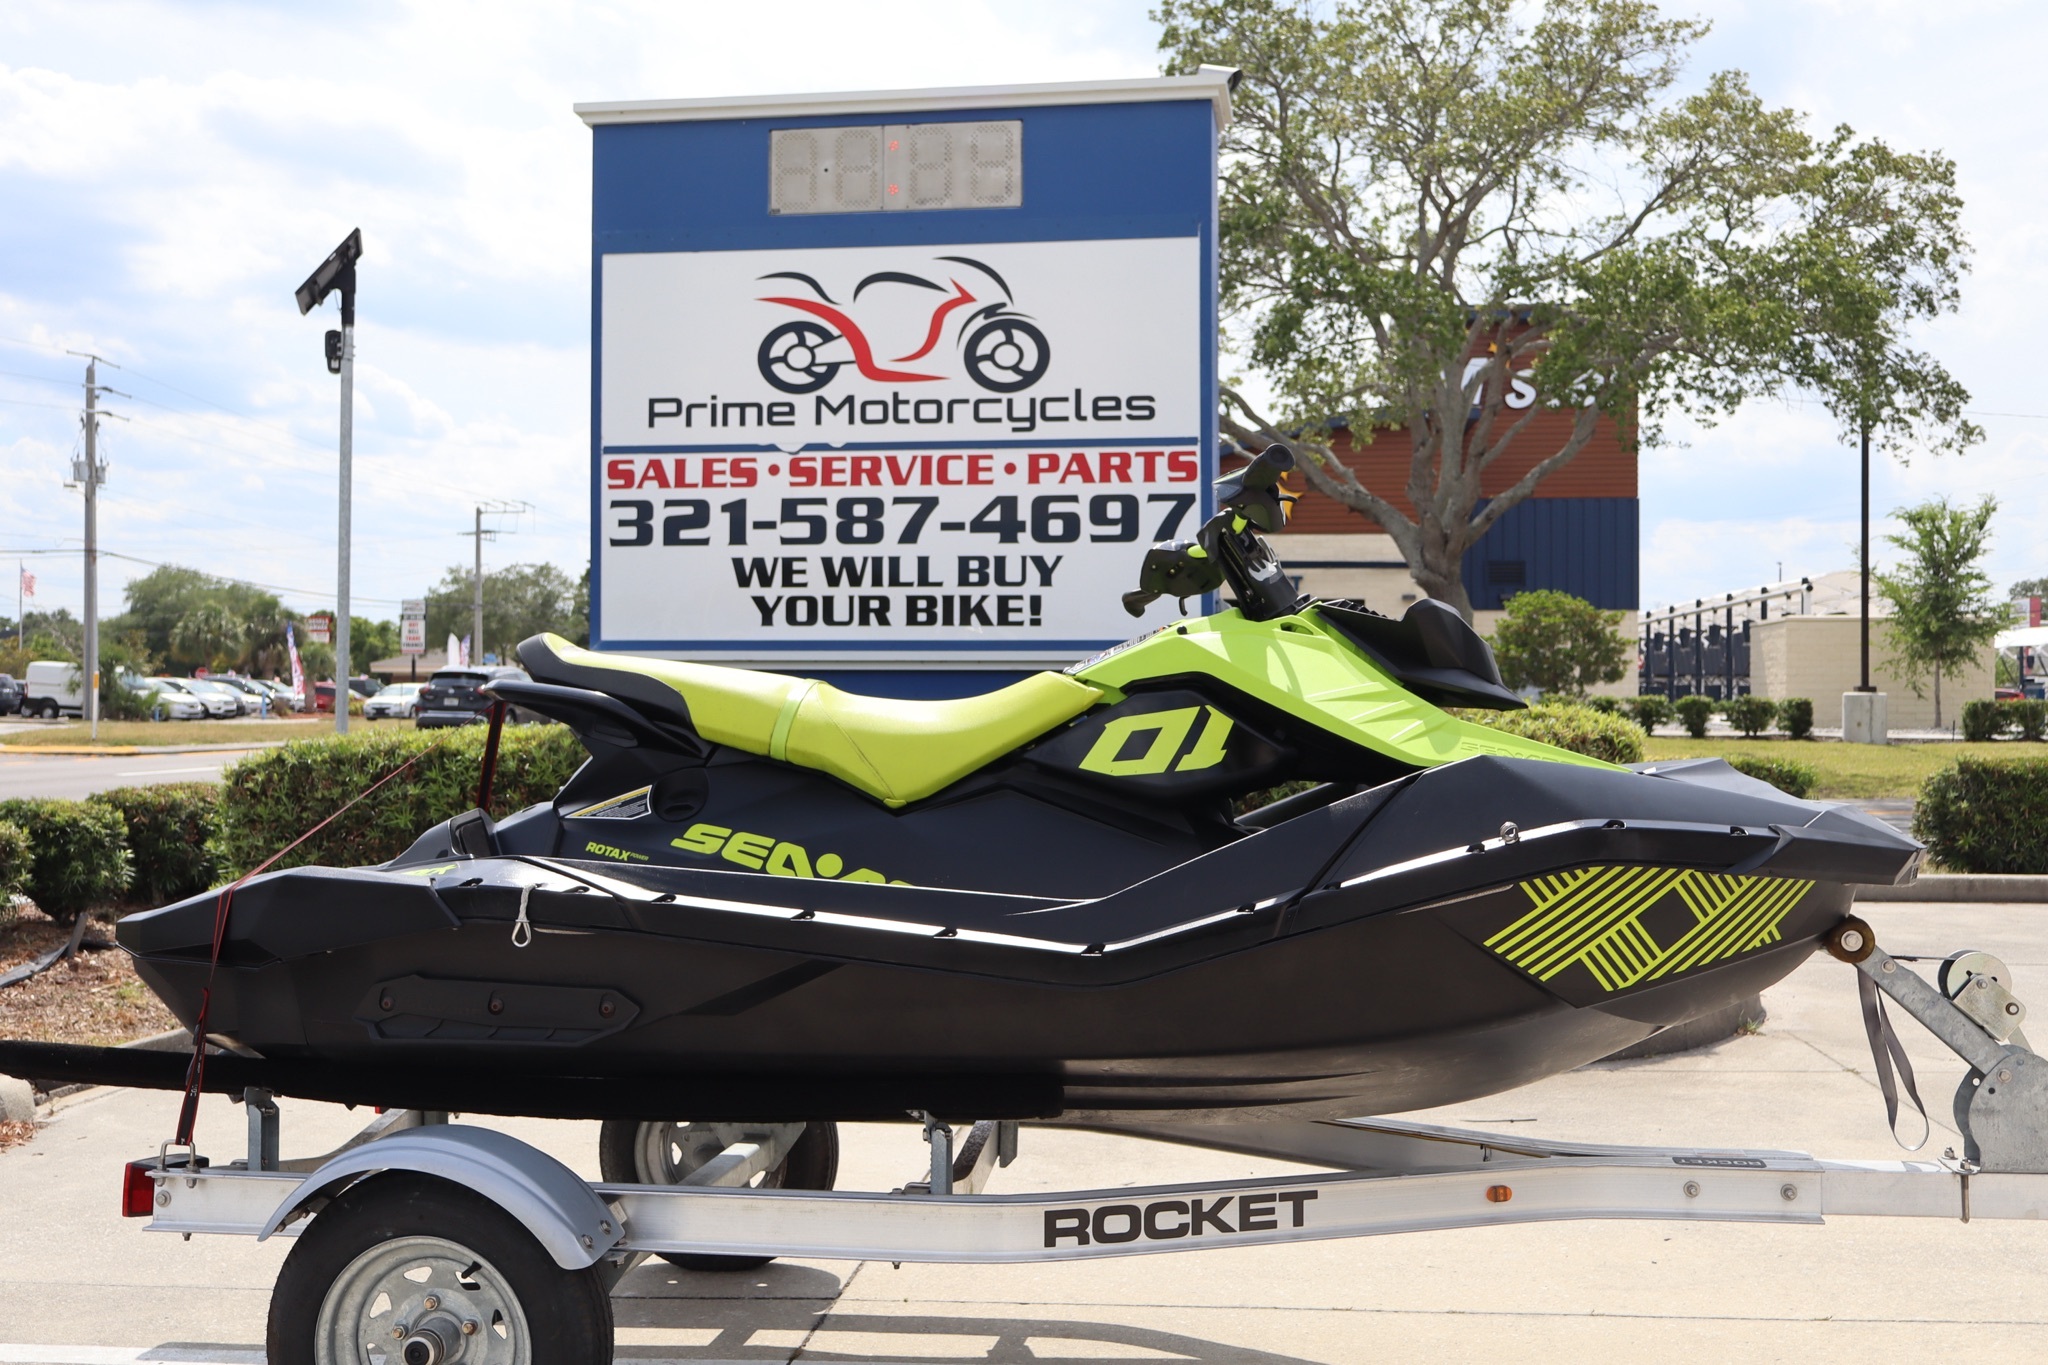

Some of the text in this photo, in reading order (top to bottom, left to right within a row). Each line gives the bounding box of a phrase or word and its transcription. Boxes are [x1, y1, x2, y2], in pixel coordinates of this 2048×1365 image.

[648, 388, 1156, 432] Prime Motorcycles
[607, 450, 1198, 490] SALES SERVICE PARTS
[608, 492, 1197, 548] 321-587-4697
[731, 555, 1063, 588] WE WILL BUY
[750, 594, 1043, 627] YOUR BIKE!
[585, 841, 649, 862] ROTAX POWER
[1044, 1190, 1319, 1248] ROCKET
